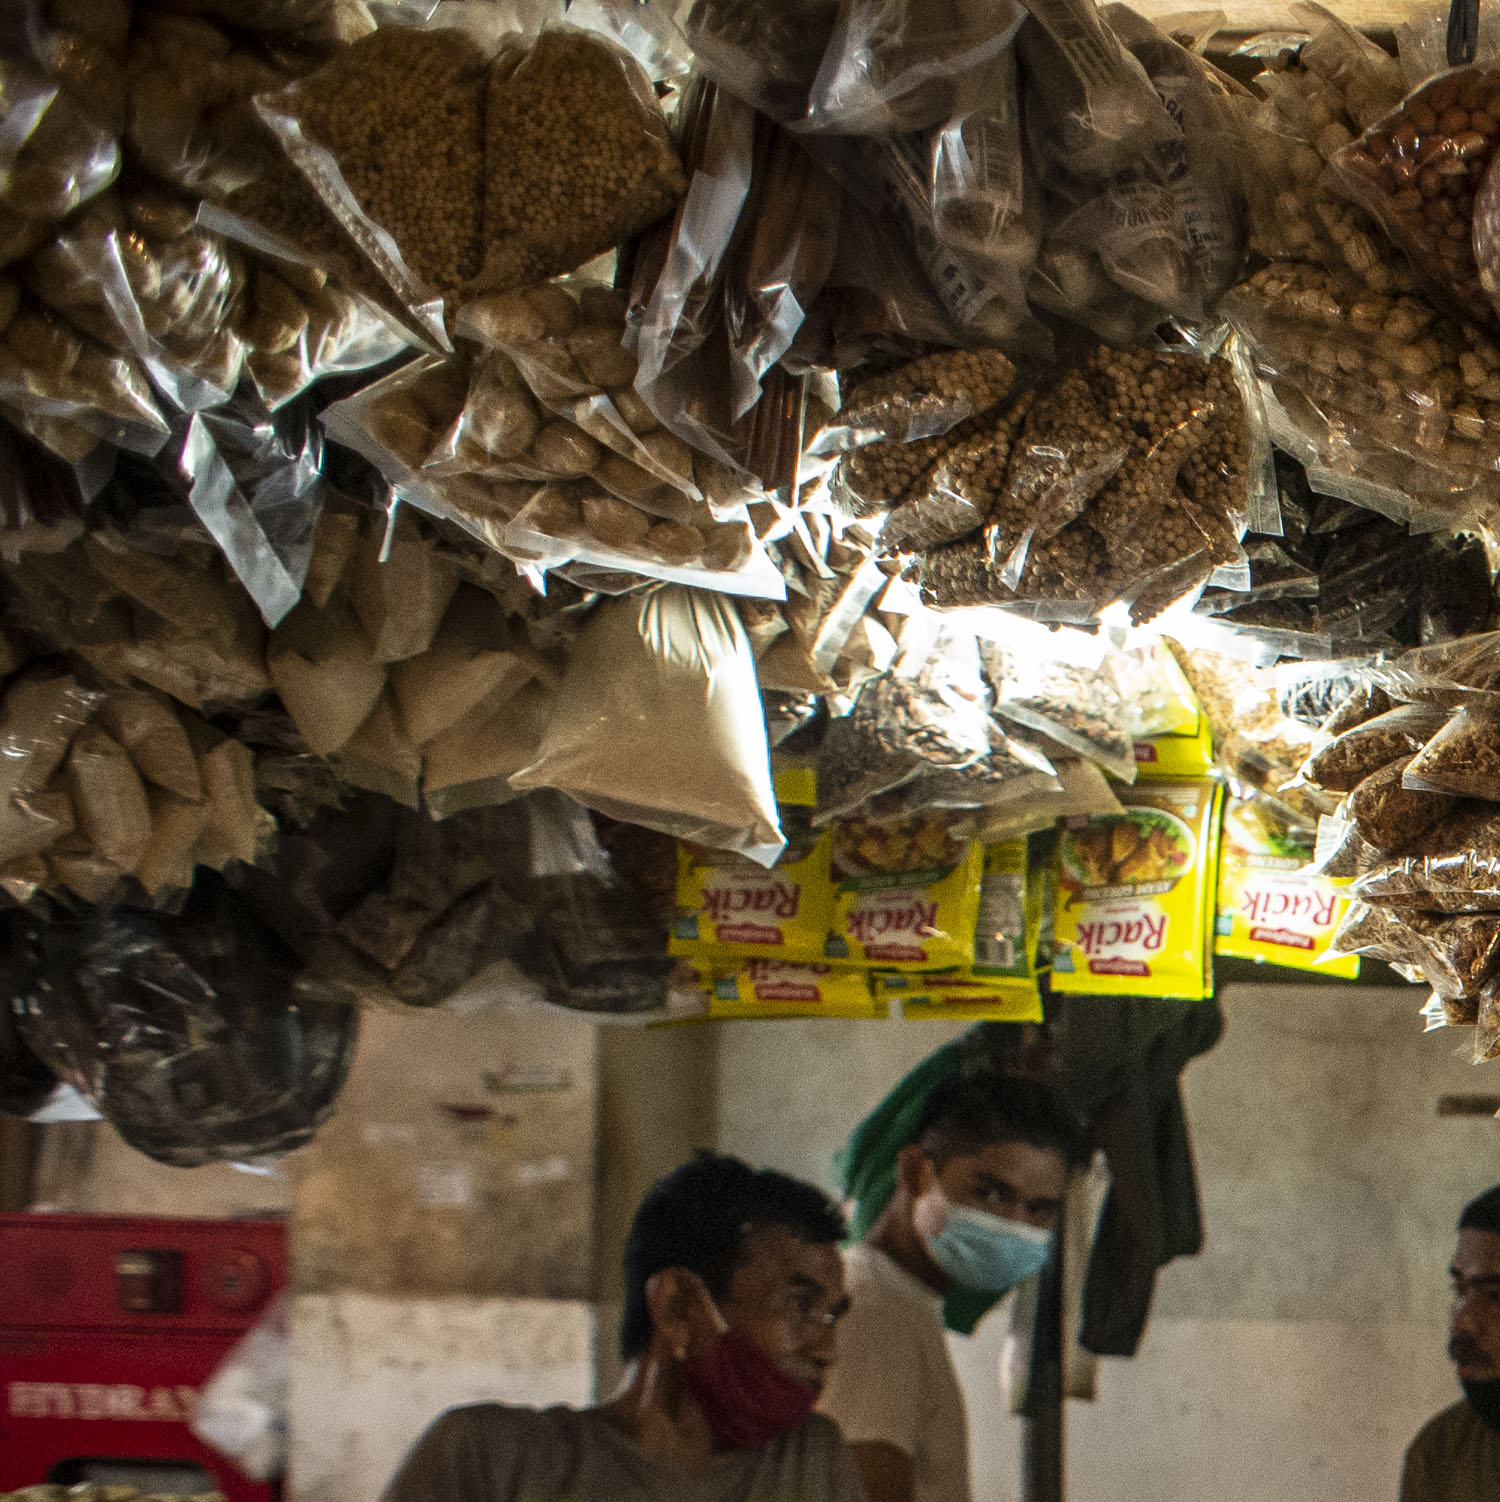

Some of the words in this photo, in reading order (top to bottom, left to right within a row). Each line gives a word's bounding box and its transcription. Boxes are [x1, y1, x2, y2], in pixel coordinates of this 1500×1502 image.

[701, 882, 801, 921] Racik
[845, 901, 939, 944] Racik
[1075, 913, 1168, 955] Racik
